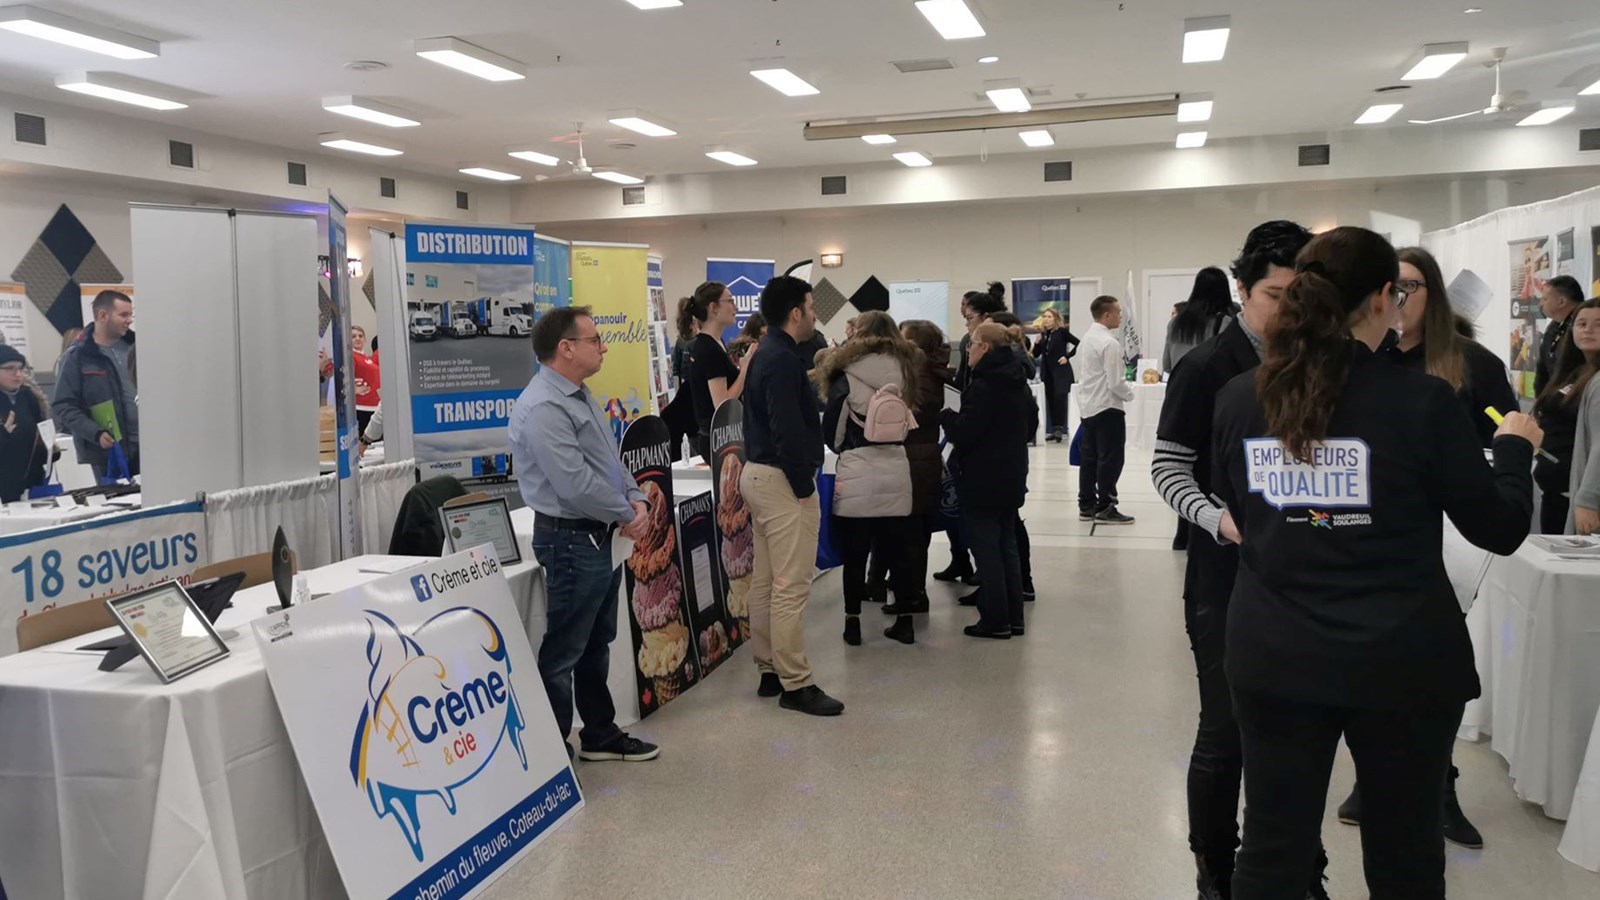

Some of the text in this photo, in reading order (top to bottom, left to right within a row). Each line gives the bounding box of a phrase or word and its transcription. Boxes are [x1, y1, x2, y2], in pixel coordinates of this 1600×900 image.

[417, 231, 528, 256] DISTRIBUTION
[590, 312, 627, 326] panouir
[600, 319, 648, 344] semble
[424, 381, 444, 389] Expertise
[434, 398, 517, 424] TRANSPOR
[621, 441, 671, 473] CHAPMAN'S
[1253, 447, 1359, 467] EMPLEURS
[1255, 468, 1359, 498] DE QUALITÉ
[680, 495, 711, 525] CHAPMAN'S
[11, 549, 65, 602] 18
[77, 532, 198, 589] saveurs
[431, 566, 470, 594] Crème
[469, 561, 483, 580] et
[482, 555, 498, 576] cie
[407, 670, 507, 744] Crème
[443, 731, 477, 766] & cie
[414, 782, 572, 900] chemin du fleuve, Coteau-du-lac
